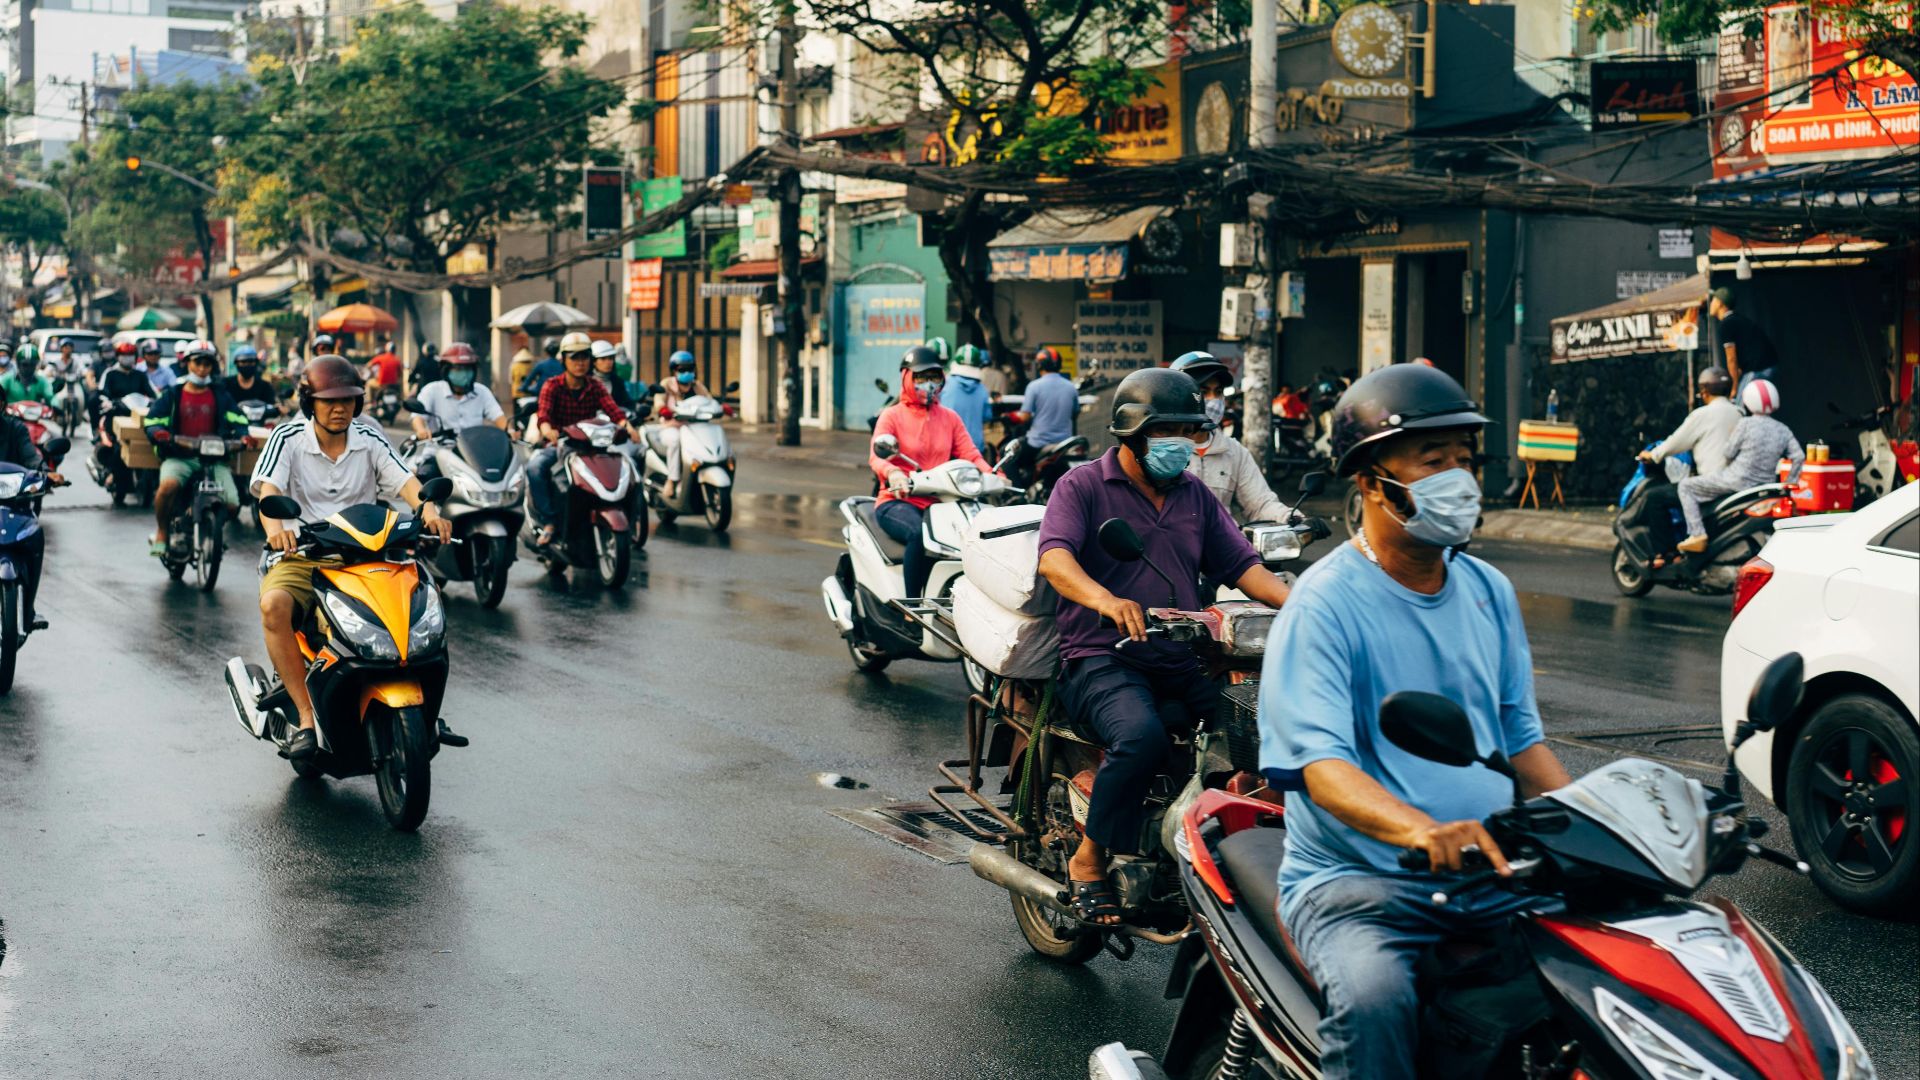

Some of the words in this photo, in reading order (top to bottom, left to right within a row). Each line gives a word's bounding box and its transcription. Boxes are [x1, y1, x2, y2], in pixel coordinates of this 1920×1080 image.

[1800, 120, 1831, 142] HÒA
[1566, 320, 1602, 346] Coffee
[1602, 313, 1651, 343] XINH
